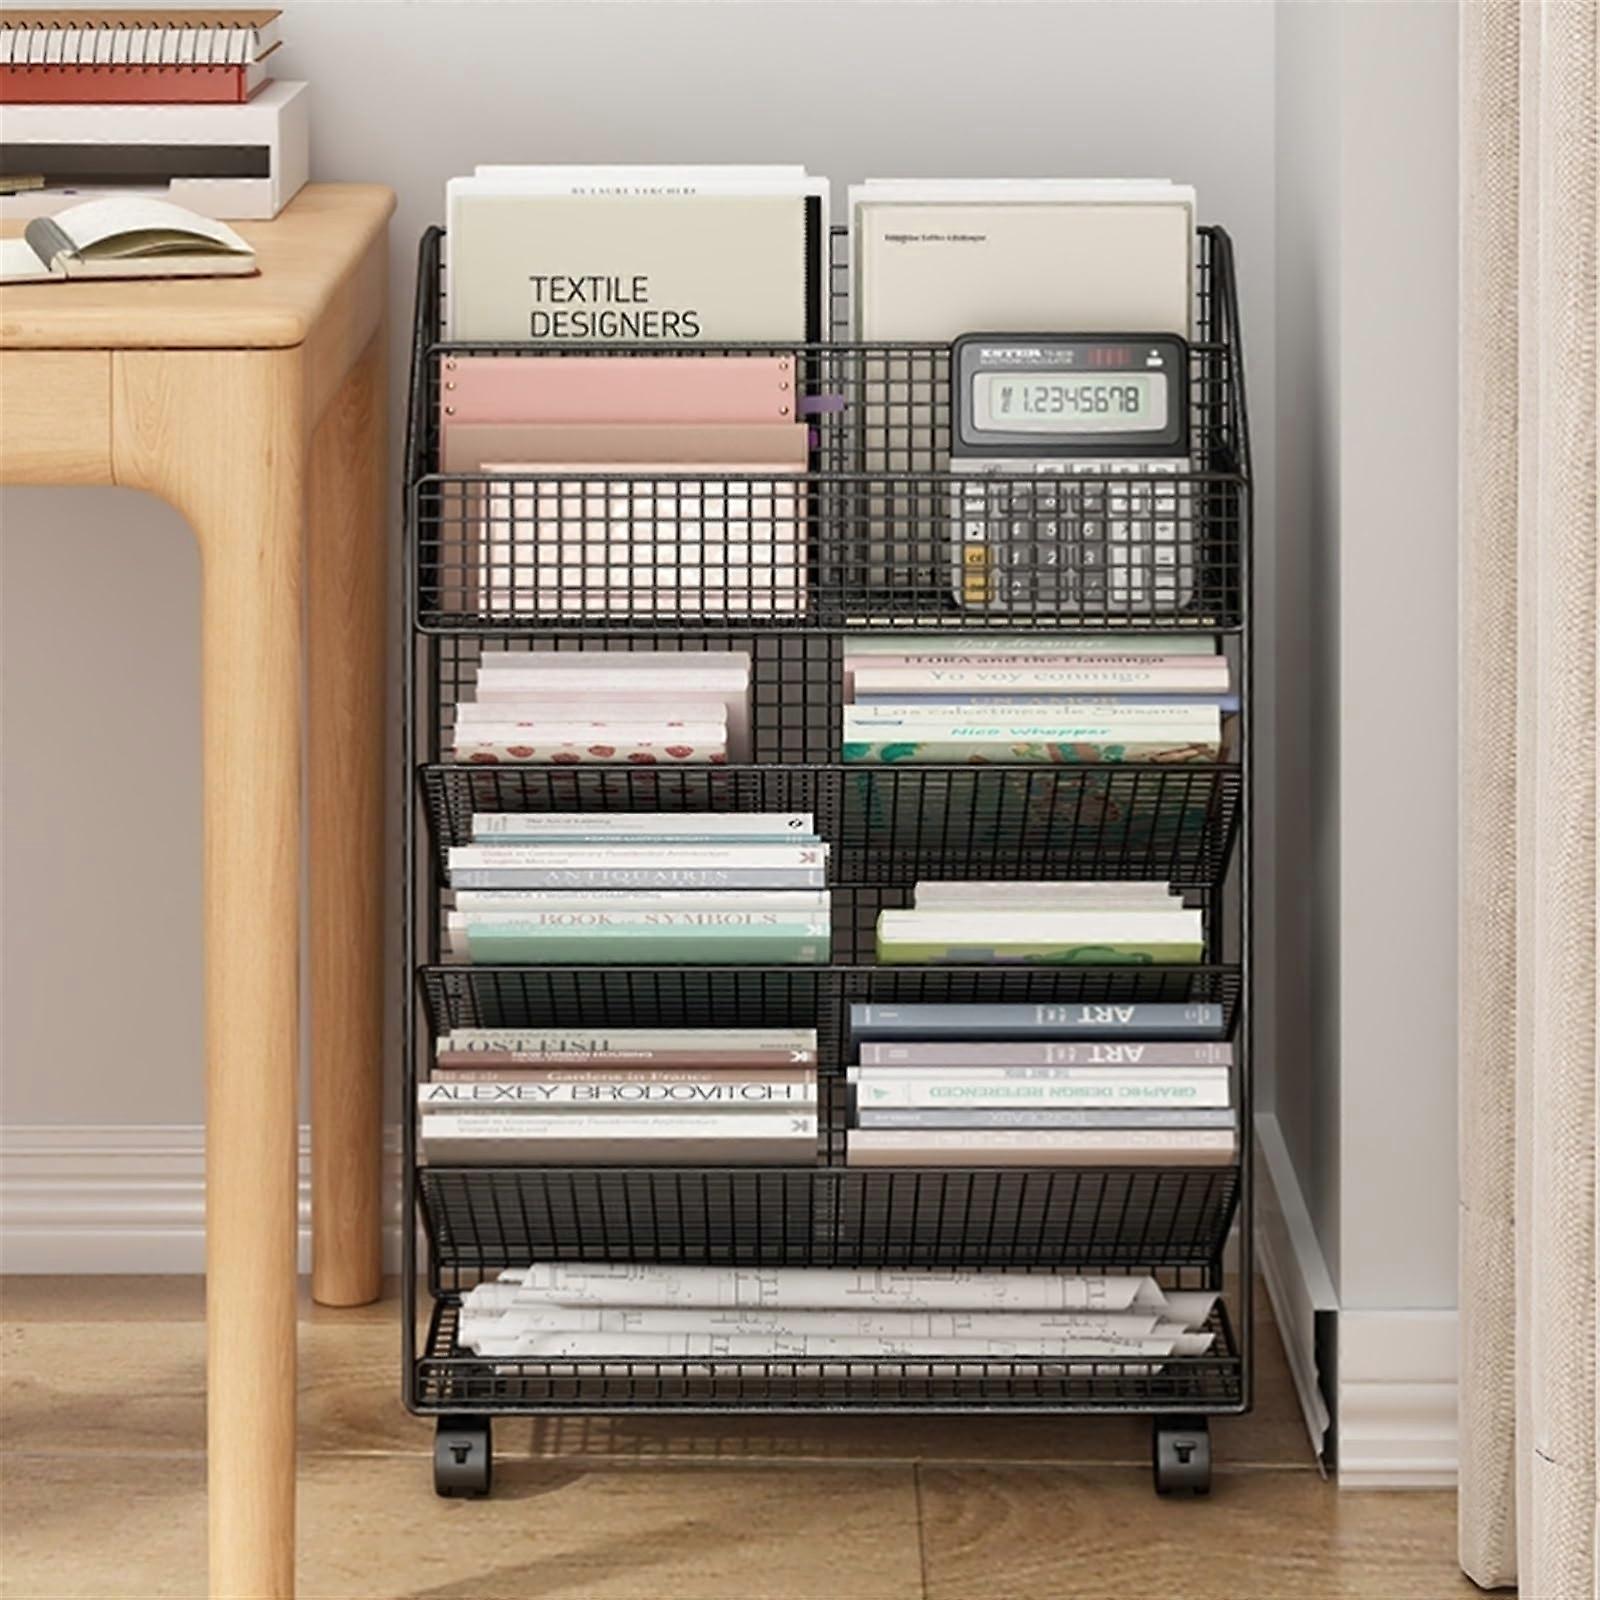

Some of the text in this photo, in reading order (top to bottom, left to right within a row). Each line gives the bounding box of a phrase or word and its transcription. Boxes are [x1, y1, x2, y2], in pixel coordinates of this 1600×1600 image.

[529, 275, 649, 303] TEXTILE
[530, 311, 701, 338] DESIGNERS
[977, 655, 1017, 664] and
[1024, 655, 1058, 664] the
[1064, 655, 1164, 665] Flamingo
[928, 671, 1151, 684] Yo voy conmigo
[544, 870, 729, 881] ANTIQUAIRES
[539, 913, 612, 925] BOOK
[645, 913, 777, 925] SYMBOLS
[1077, 1005, 1135, 1023] ART
[450, 1039, 608, 1052] LOST FISH
[1088, 1045, 1145, 1063] ART
[547, 1072, 713, 1081] Gardens in France
[428, 1085, 791, 1100] ALEXEY BRODOVITCH
[929, 1086, 1197, 1098] GRAPHIC DESIGN REFERENCED
